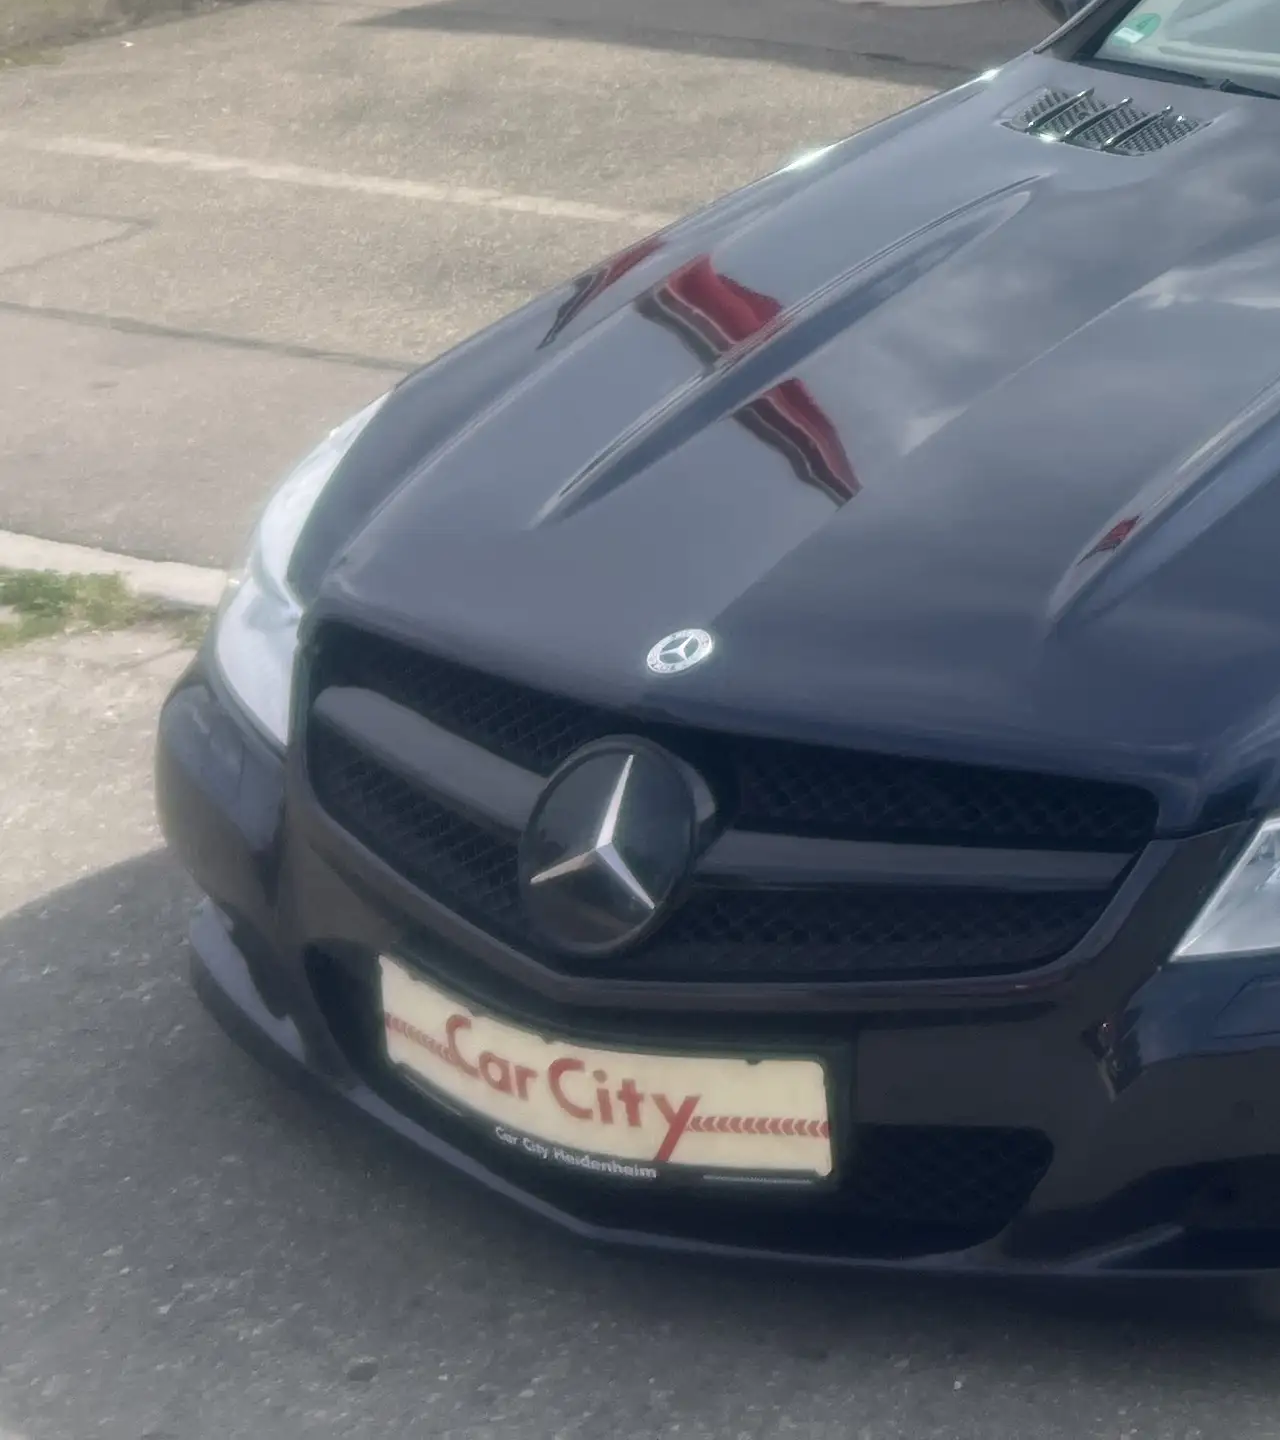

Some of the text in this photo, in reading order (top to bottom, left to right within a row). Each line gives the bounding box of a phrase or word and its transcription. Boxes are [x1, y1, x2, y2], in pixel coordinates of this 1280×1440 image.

[495, 1126, 657, 1178] Car City Heidenheim
